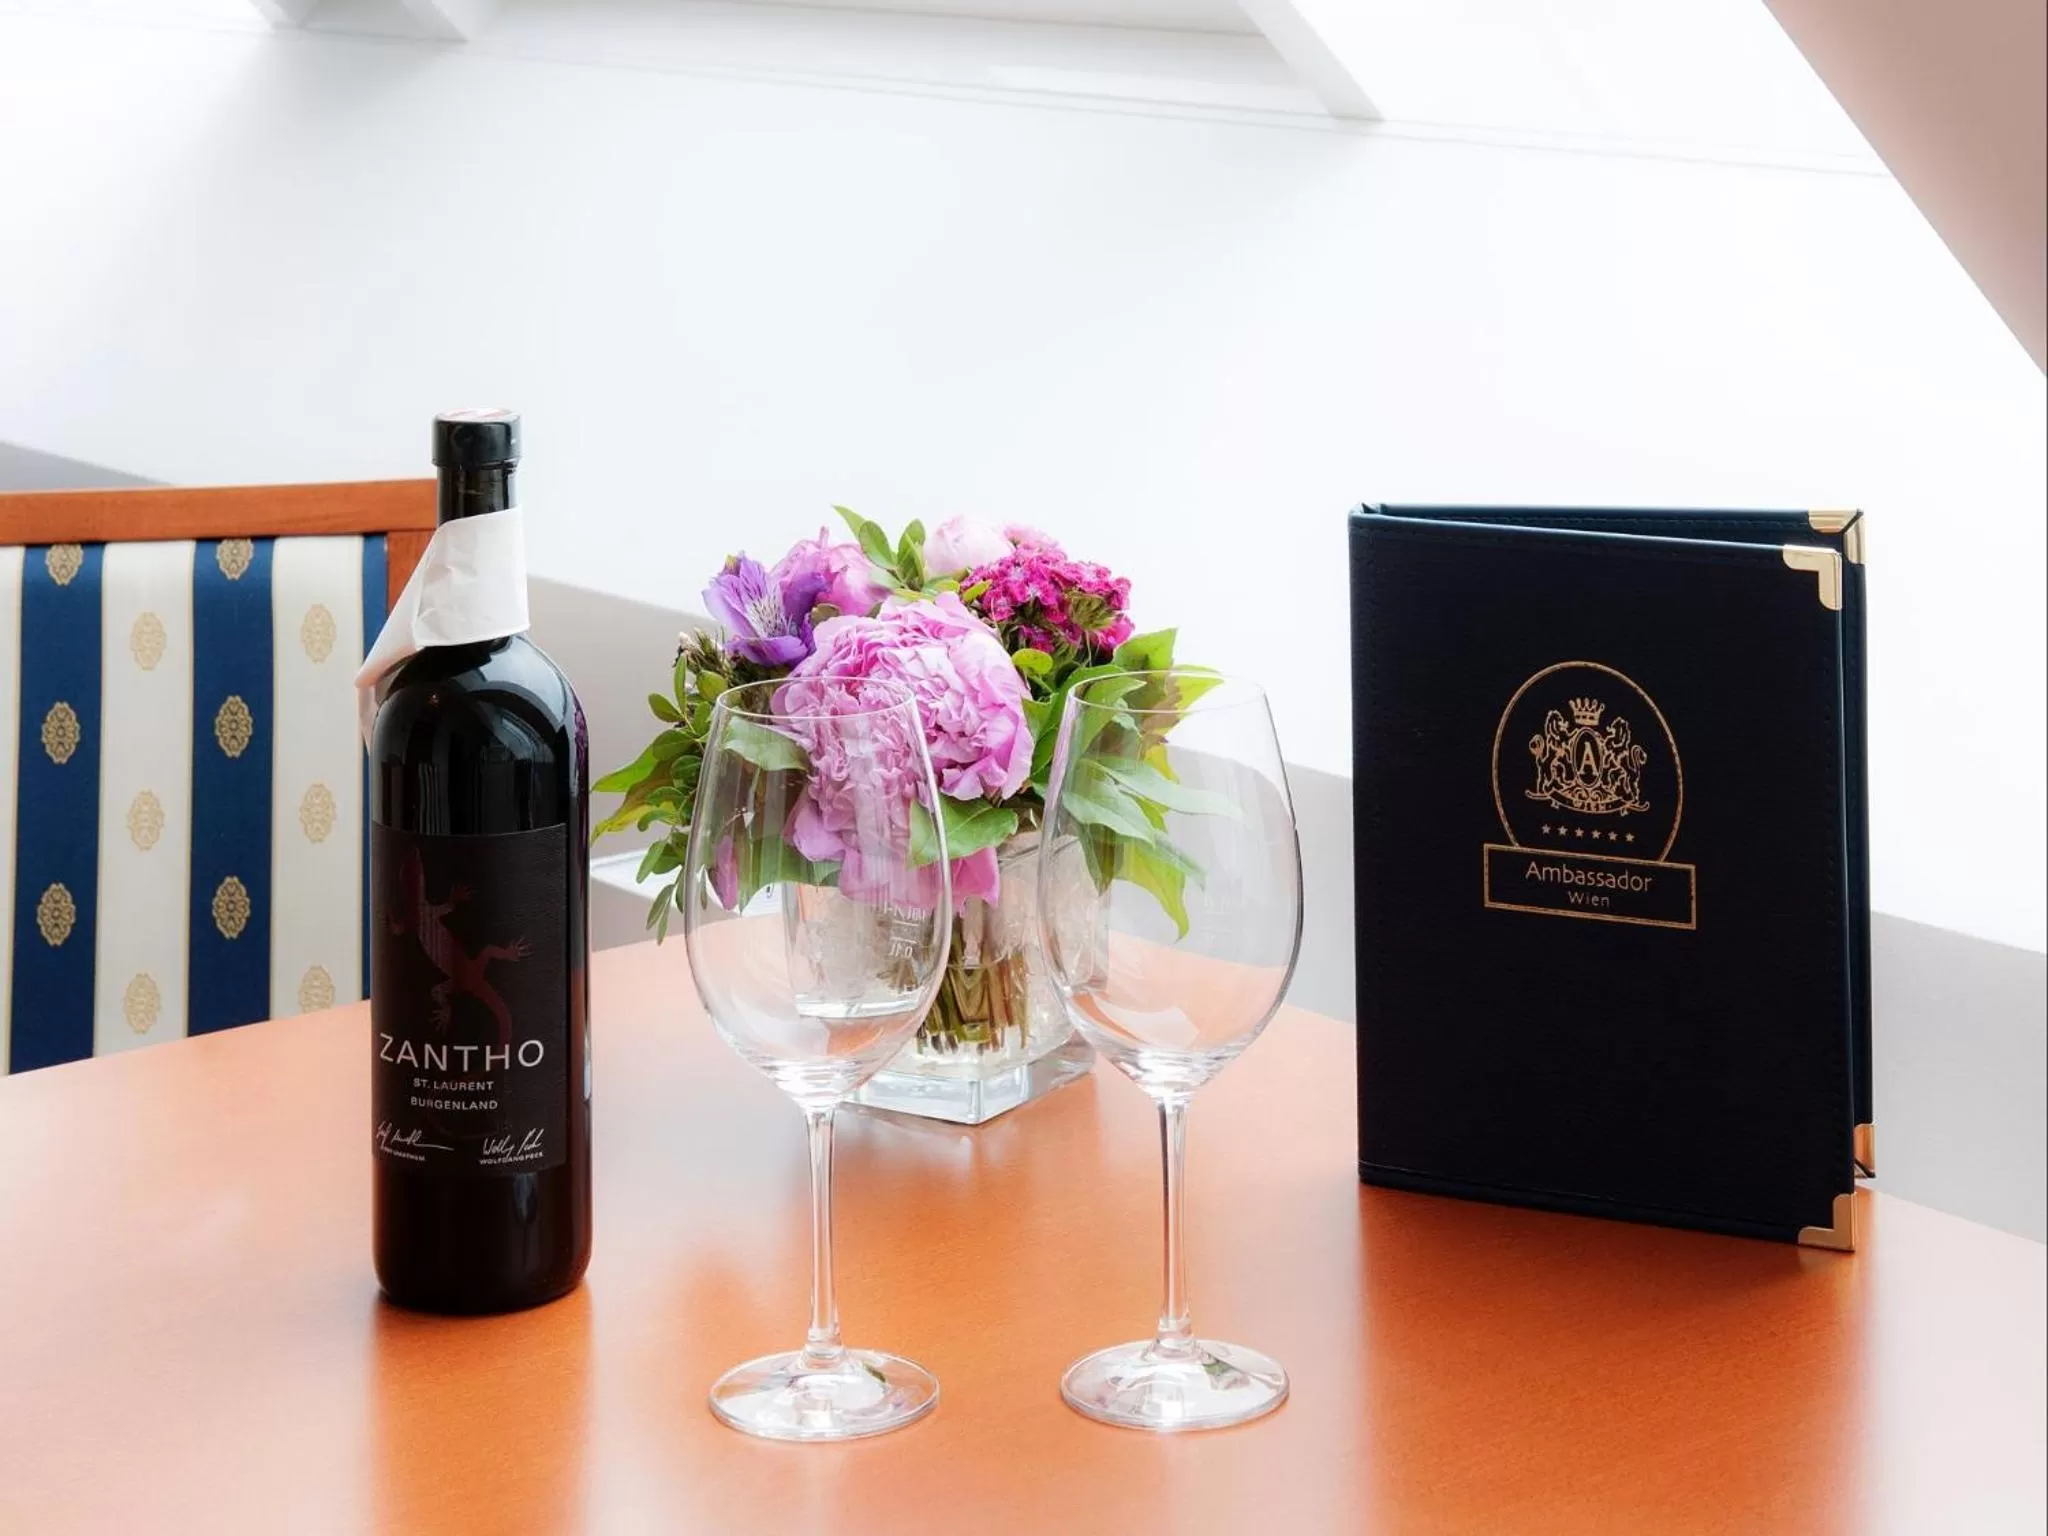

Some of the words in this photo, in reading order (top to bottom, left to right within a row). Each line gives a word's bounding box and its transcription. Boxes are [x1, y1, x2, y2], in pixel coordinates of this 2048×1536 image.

[1577, 741, 1600, 776] A
[1525, 860, 1653, 893] Ambassador
[1567, 890, 1610, 908] Wien
[379, 1032, 545, 1073] ZANTHO
[413, 1077, 431, 1090] ST.
[433, 1080, 495, 1092] LAURENT
[410, 1095, 499, 1111] BURGENLAND
